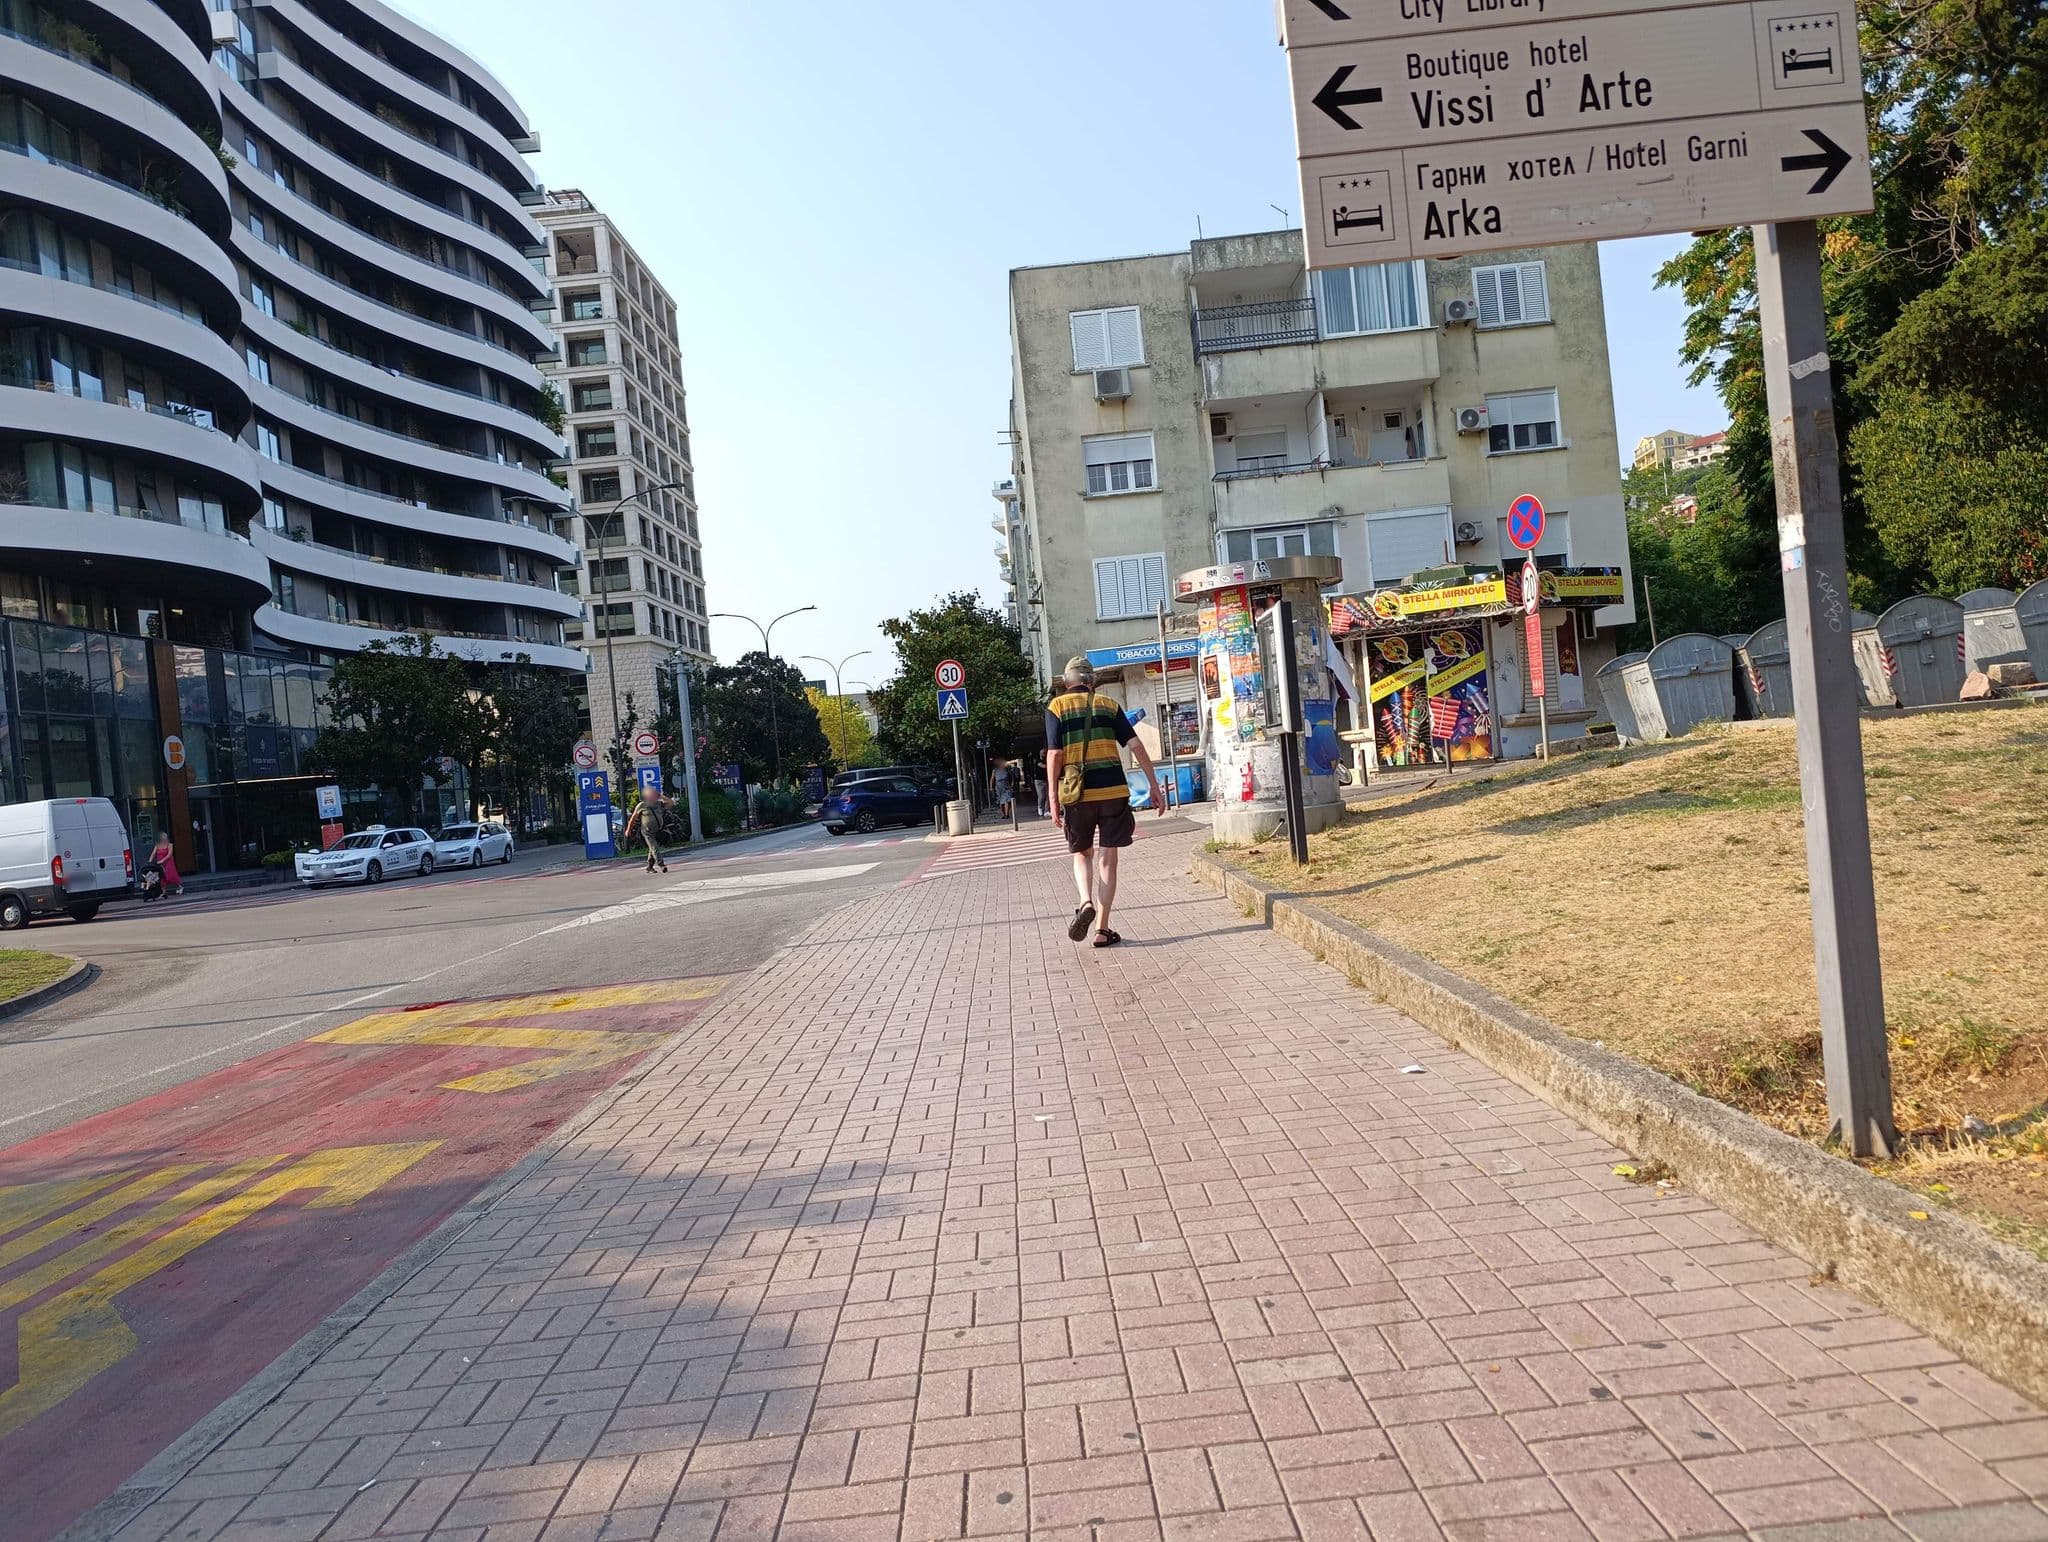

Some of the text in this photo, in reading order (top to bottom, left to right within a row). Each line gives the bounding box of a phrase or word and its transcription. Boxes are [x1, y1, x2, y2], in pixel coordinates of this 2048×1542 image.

[1406, 35, 1588, 80] Boutique hotel
[1410, 85, 1494, 129] Vissi
[1579, 71, 1652, 113] Arte
[1417, 163, 1486, 194] Гарни
[1508, 153, 1576, 181] хотел
[1605, 139, 1667, 170] Hotel
[1688, 132, 1748, 162] Garni
[1423, 198, 1502, 240] Arka
[1403, 593, 1440, 604] STELLA
[1442, 584, 1496, 599] MIRNOVEC
[1525, 574, 1535, 602] 20
[1558, 578, 1618, 587] STELLA MIRNOVEC
[1116, 648, 1157, 660] TOBACCO
[1167, 643, 1196, 653] PRESS
[942, 667, 958, 682] 30
[1430, 675, 1451, 688] STELLA
[1450, 658, 1482, 678] MIRNOVEC
[582, 777, 591, 790] P
[643, 769, 656, 788] P
